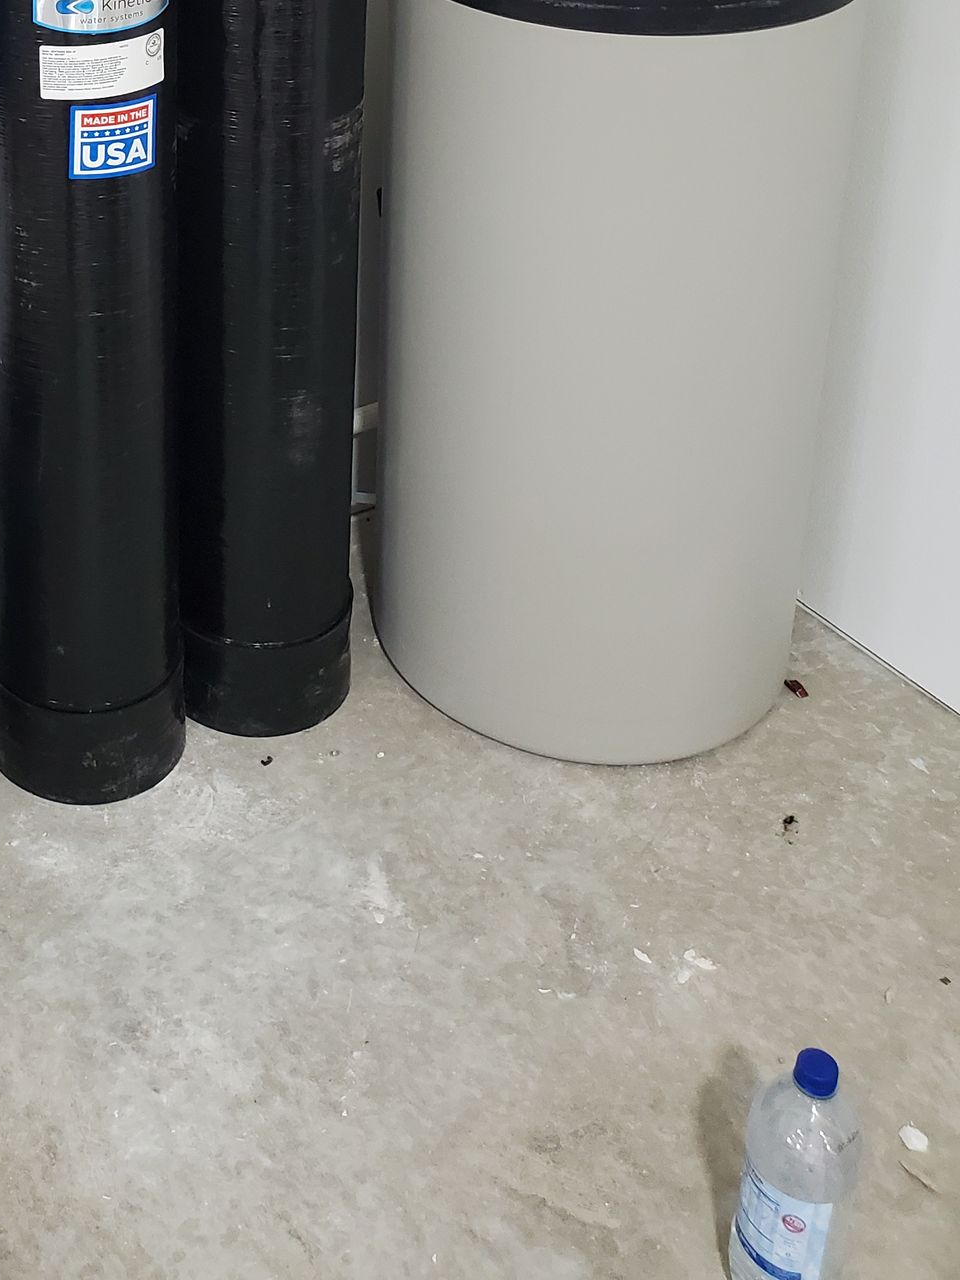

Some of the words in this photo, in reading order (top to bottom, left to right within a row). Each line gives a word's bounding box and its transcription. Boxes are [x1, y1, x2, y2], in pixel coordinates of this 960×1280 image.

[110, 10, 143, 22] systems
[83, 115, 116, 126] MADE
[117, 113, 128, 123] IN
[129, 108, 147, 121] THE
[82, 138, 147, 169] USA
